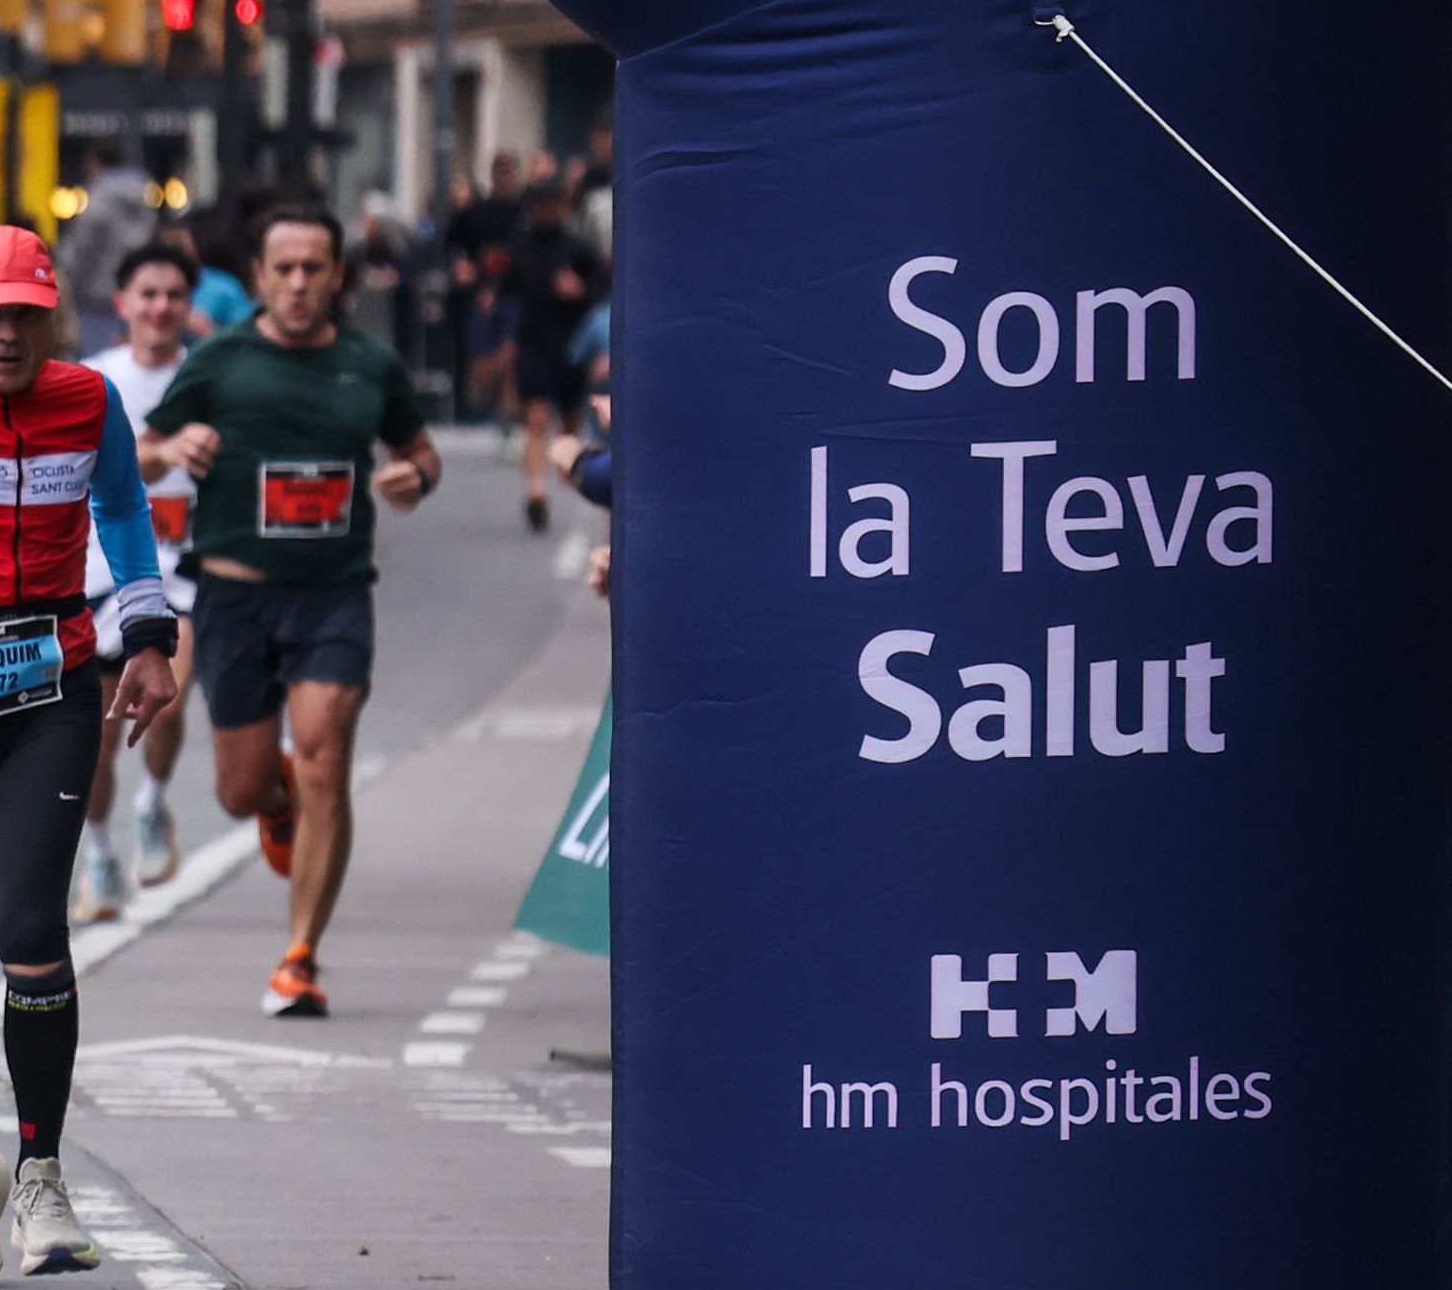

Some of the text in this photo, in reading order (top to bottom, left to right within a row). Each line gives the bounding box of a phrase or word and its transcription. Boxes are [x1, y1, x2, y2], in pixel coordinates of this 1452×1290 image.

[887, 255, 1197, 391] Som
[31, 481, 62, 495] SANT
[32, 464, 76, 478] CICLISTA
[810, 440, 1273, 578] la Teva
[858, 624, 1226, 764] Salut
[802, 1055, 1274, 1141] hm hospitales
